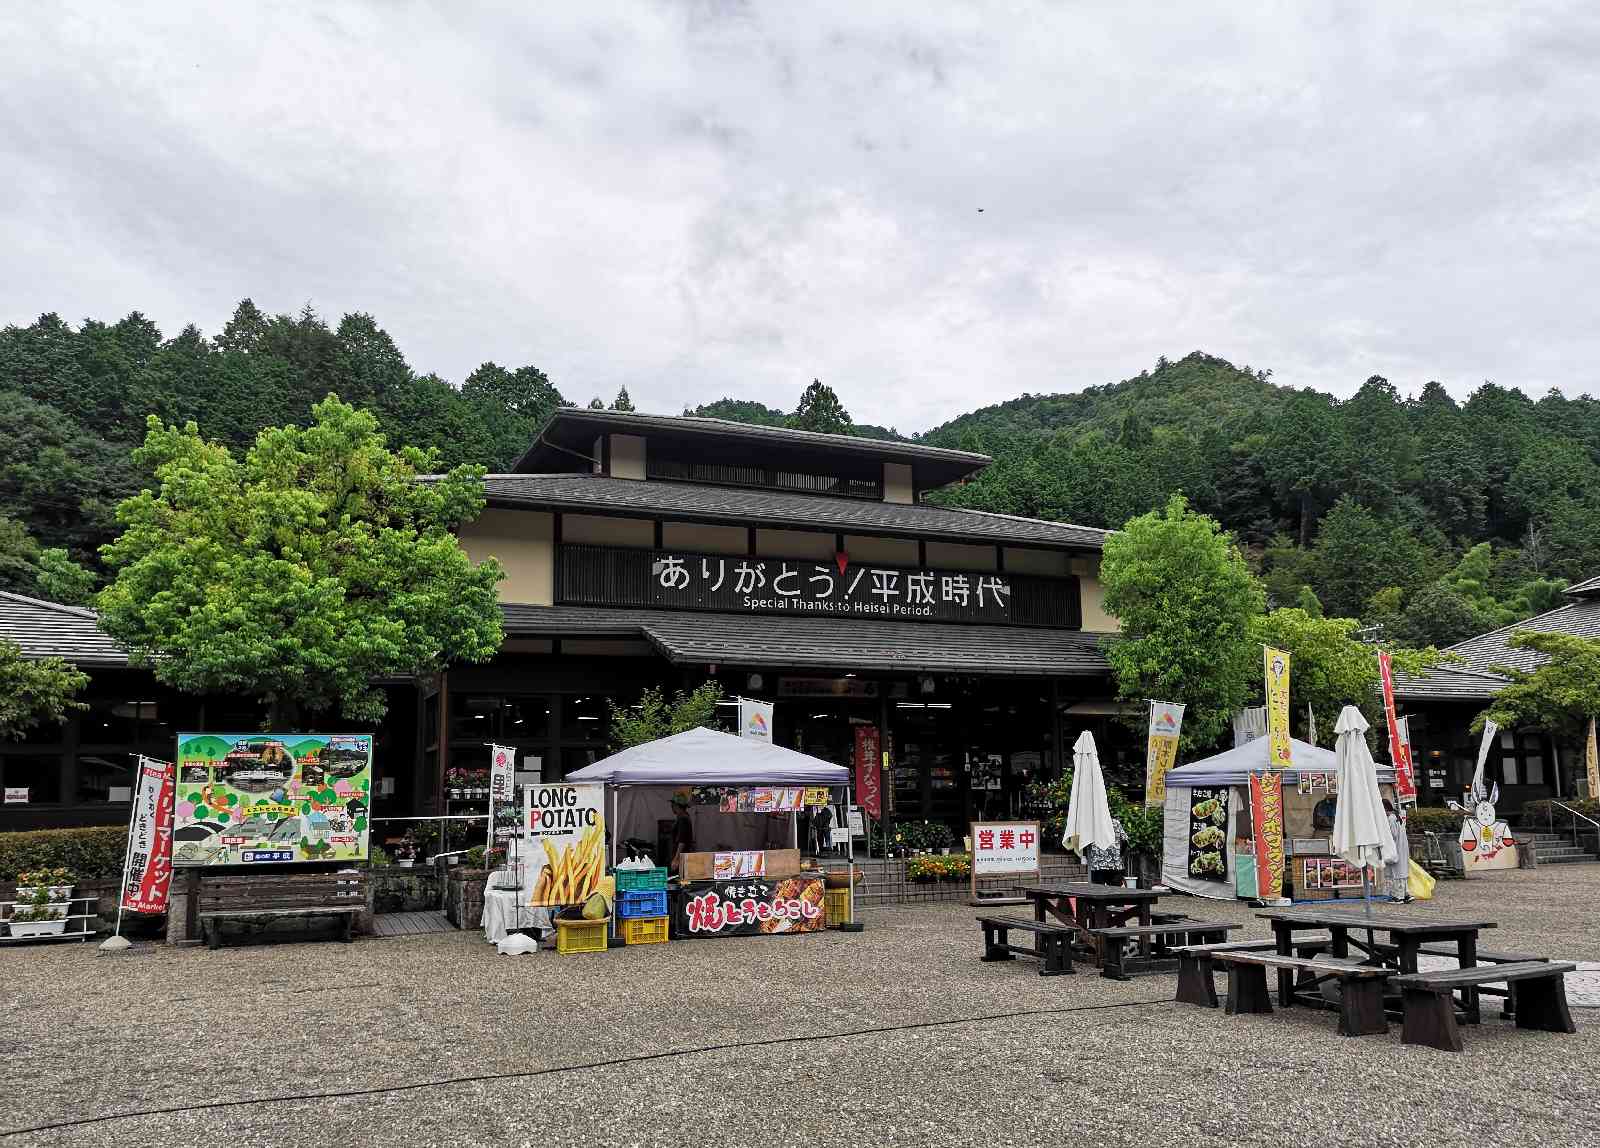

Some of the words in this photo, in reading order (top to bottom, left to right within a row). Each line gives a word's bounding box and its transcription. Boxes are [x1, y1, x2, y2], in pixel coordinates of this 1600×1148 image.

[743, 596, 788, 609] Special
[792, 598, 834, 611] Thanks
[838, 601, 850, 612] to
[854, 601, 889, 614] Heisei
[893, 603, 933, 616] Period.
[531, 787, 577, 808] LONG
[530, 808, 597, 829] POTATO
[979, 830, 1035, 850] 営業中
[128, 852, 148, 895] 開催中
[724, 884, 769, 898] 焼き立て
[686, 891, 818, 933] 焼とうもろこし
